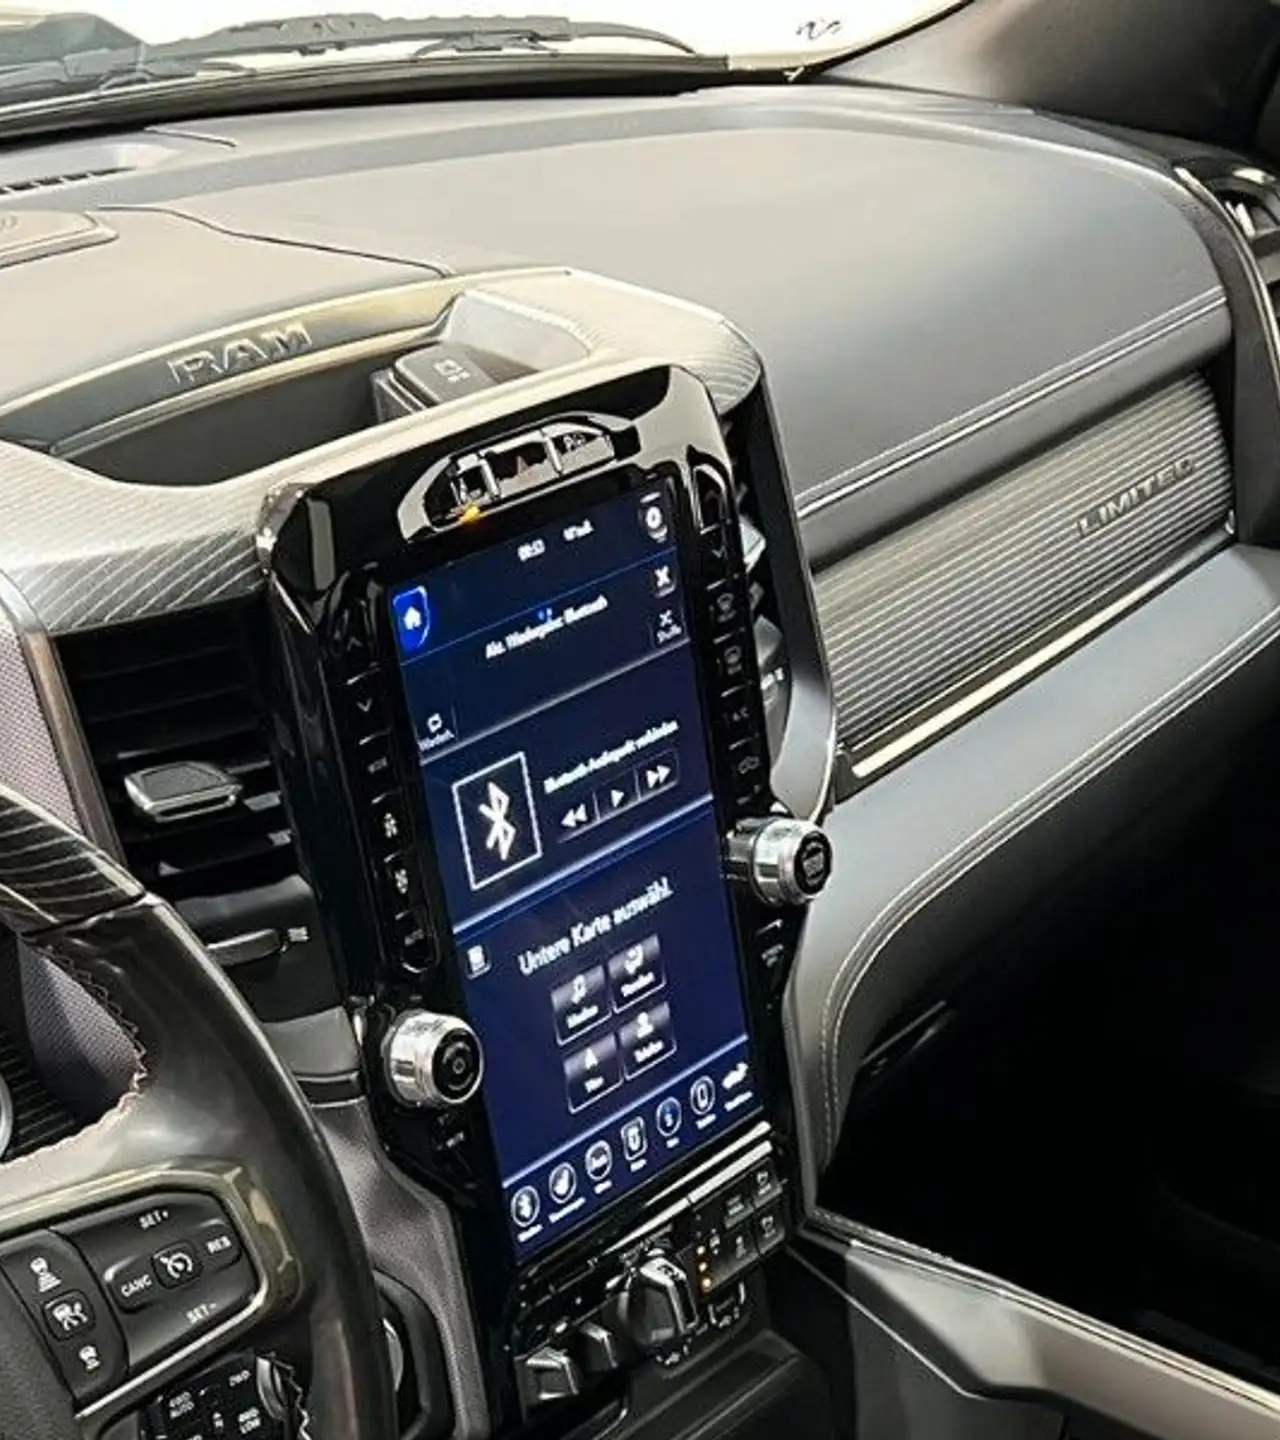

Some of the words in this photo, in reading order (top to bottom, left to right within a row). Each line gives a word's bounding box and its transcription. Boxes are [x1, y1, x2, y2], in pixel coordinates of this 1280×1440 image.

[167, 322, 312, 385] RAM
[1077, 456, 1197, 538] LIMITED
[571, 915, 612, 946] Karte
[121, 1274, 152, 1297] CANC
